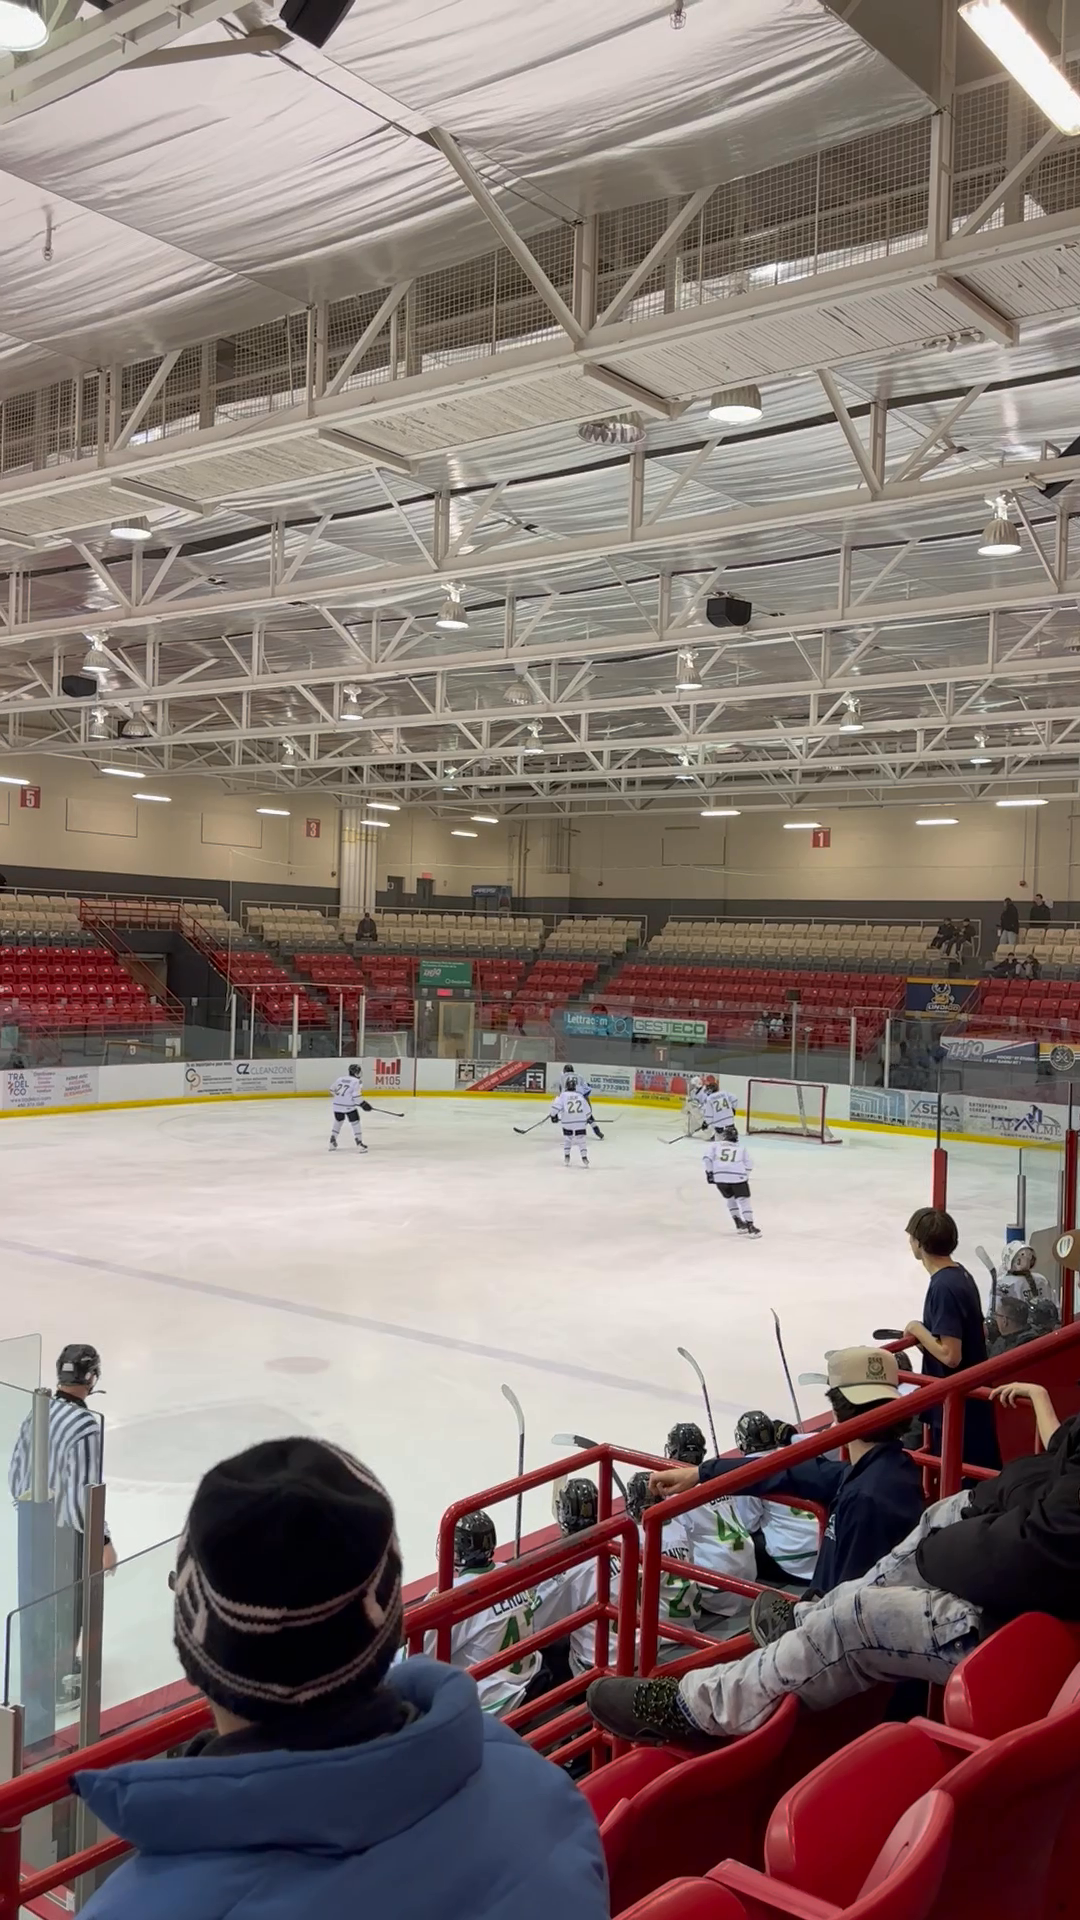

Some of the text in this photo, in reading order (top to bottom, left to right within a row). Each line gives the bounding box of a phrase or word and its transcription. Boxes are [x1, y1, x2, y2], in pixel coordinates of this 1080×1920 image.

[26, 790, 35, 807] 5
[310, 822, 317, 837] 3
[818, 832, 824, 847] 1
[634, 1020, 706, 1035] GESTECO
[659, 1049, 664, 1061] 1
[236, 1063, 250, 1075] CZ
[250, 1066, 294, 1076] CLEANZONE
[14, 1080, 29, 1088] DEL
[375, 1076, 401, 1086] M105
[13, 1088, 27, 1096] CO
[334, 1083, 350, 1097] 27
[567, 1100, 583, 1114] 22
[713, 1097, 730, 1113] 24
[720, 1148, 738, 1163] 51
